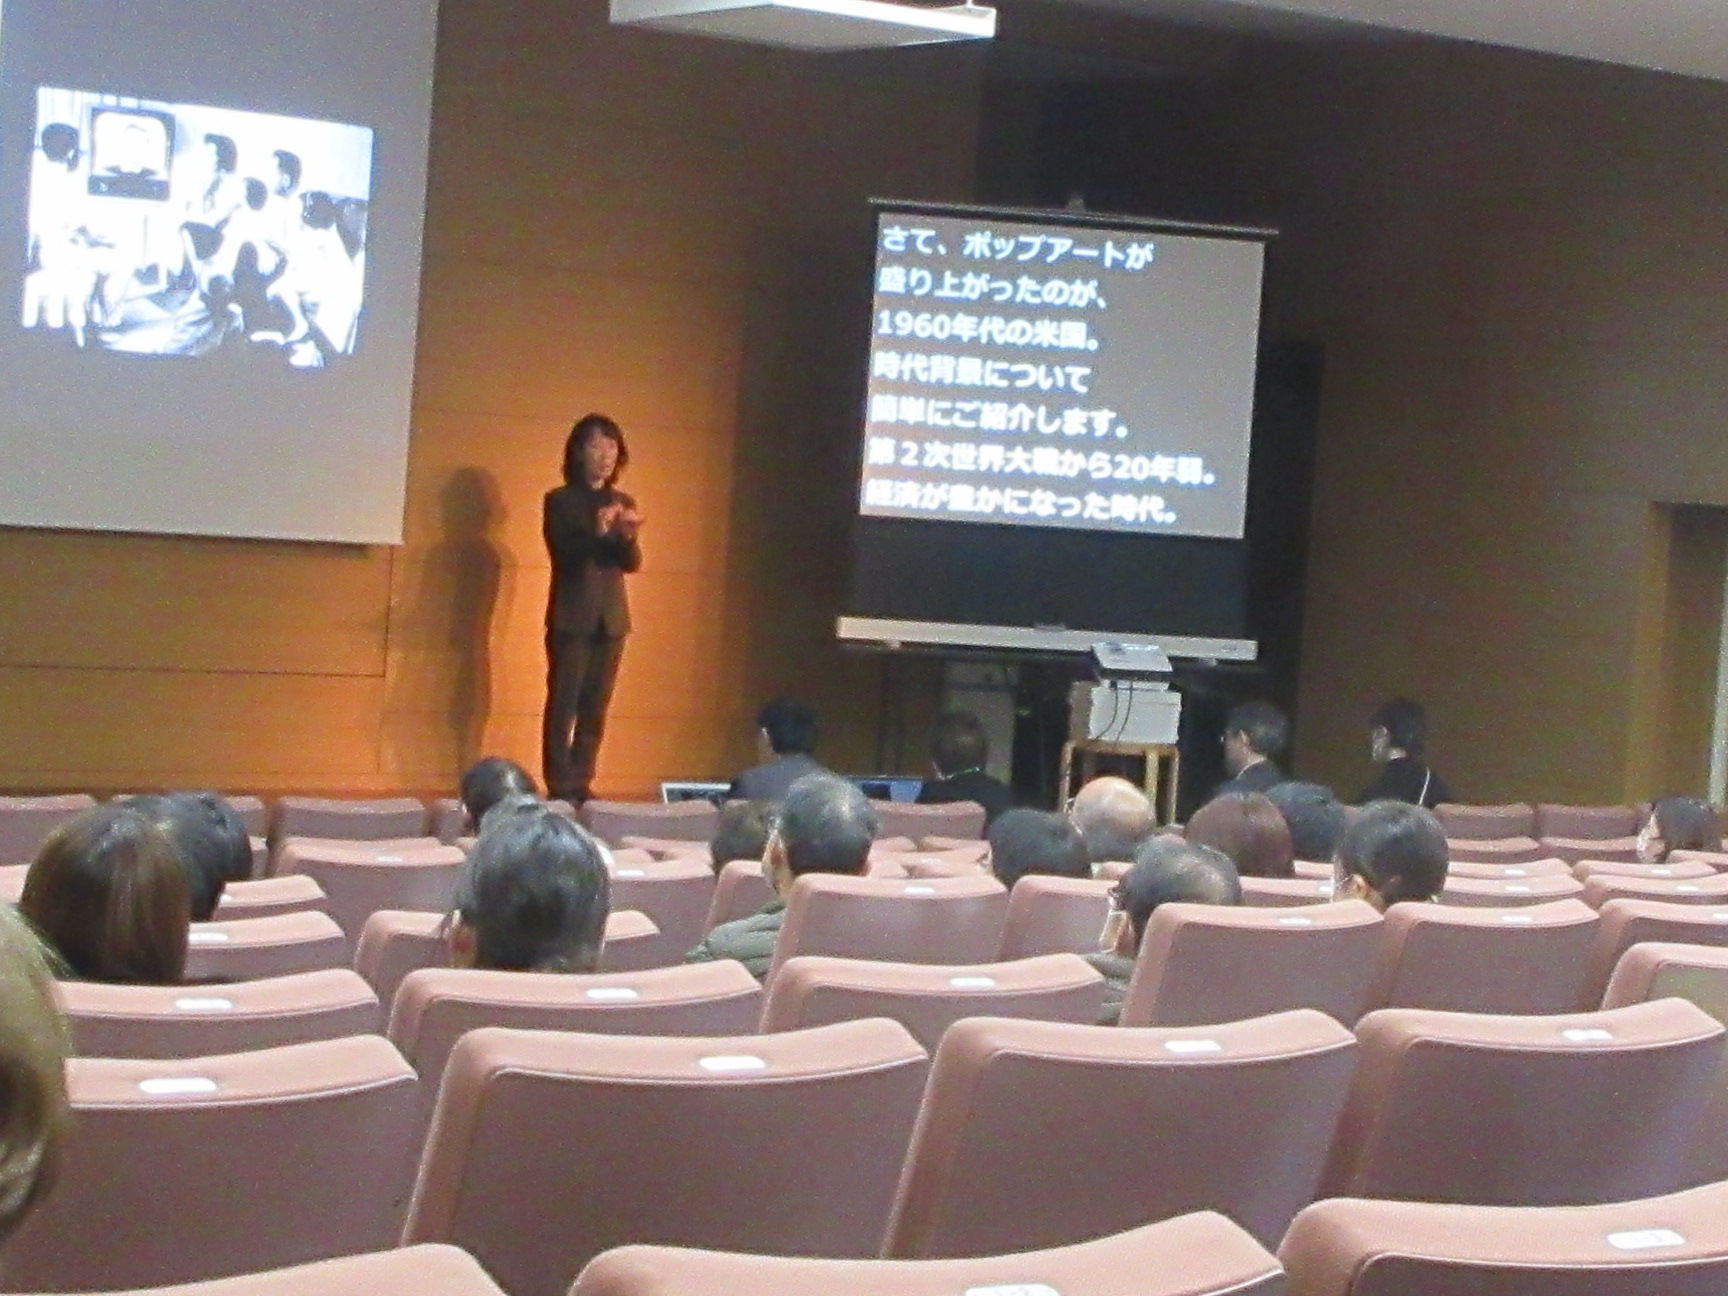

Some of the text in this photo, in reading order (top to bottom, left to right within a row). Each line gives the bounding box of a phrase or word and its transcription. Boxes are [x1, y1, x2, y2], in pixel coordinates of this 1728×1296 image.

[878, 266, 1108, 309] 盛り上がったのが、
[878, 310, 1100, 351] 1960年代の米国。
[874, 351, 1091, 393] 時代背景について
[872, 394, 1128, 438] 簡単にご紹介します。
